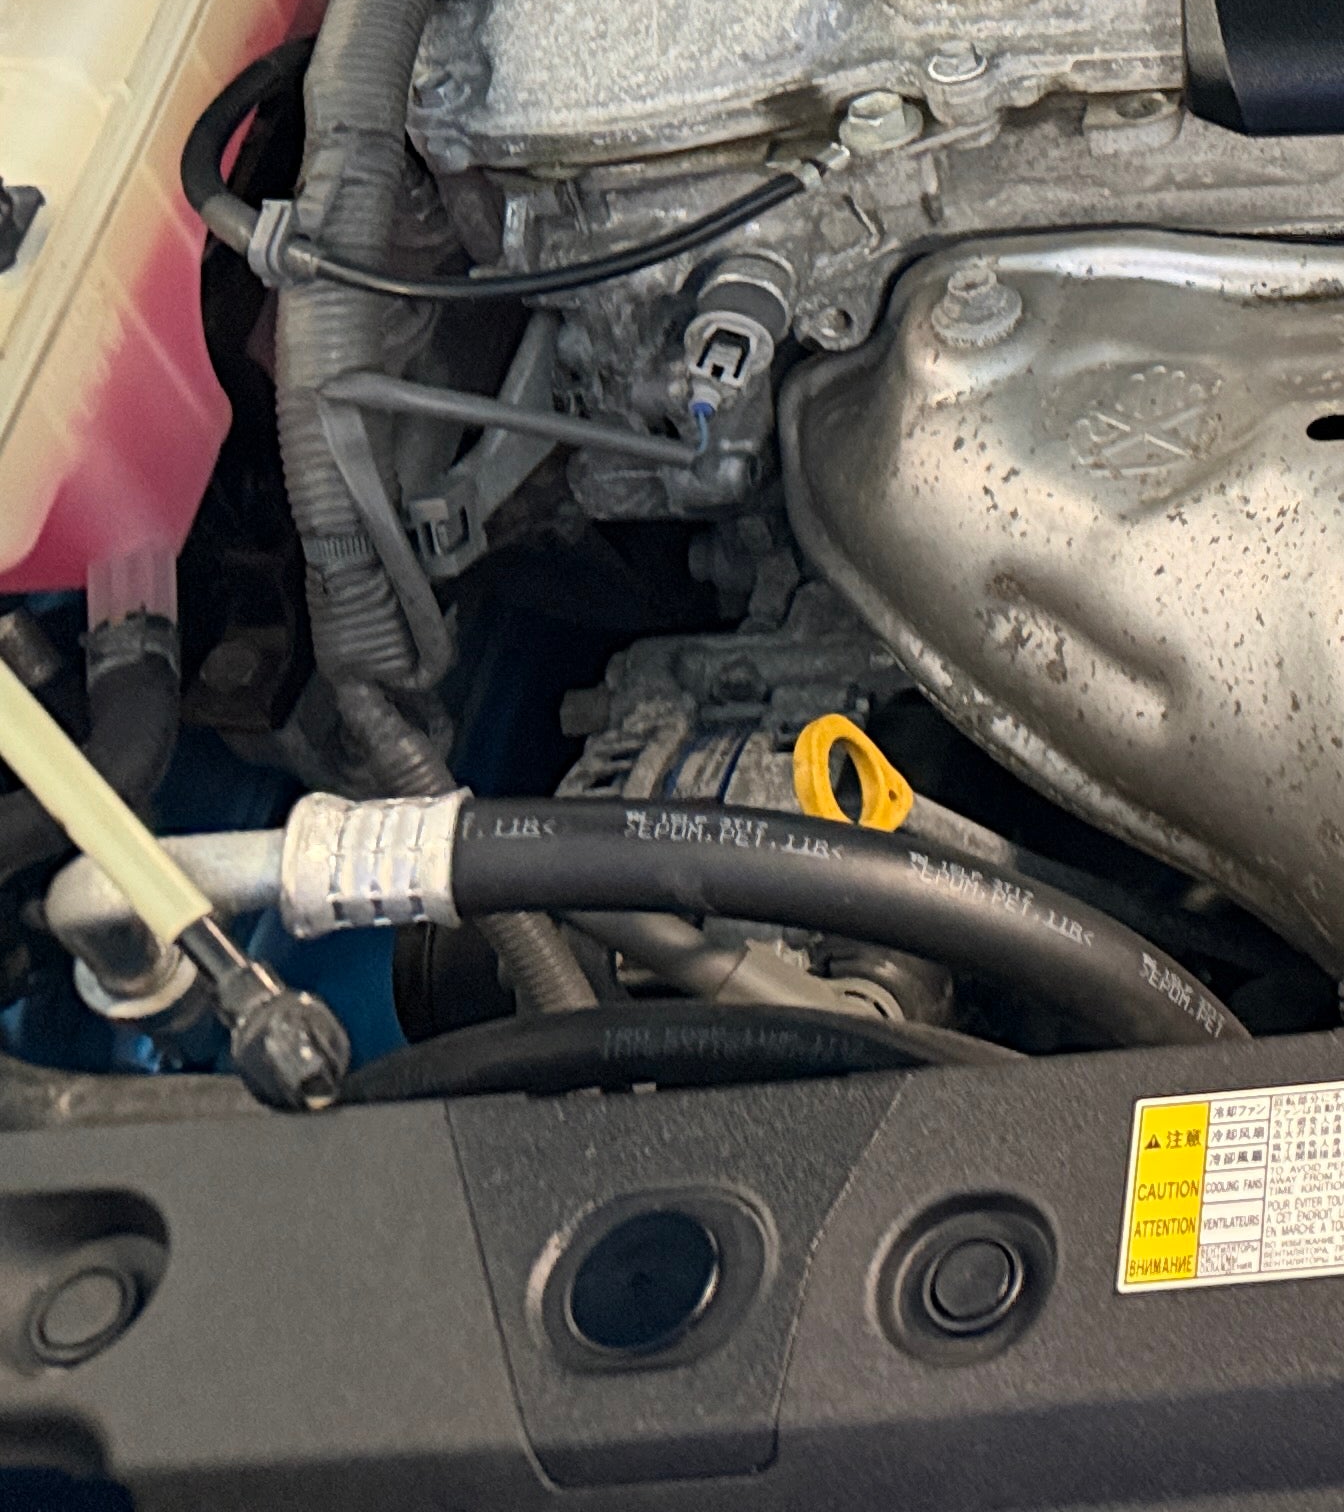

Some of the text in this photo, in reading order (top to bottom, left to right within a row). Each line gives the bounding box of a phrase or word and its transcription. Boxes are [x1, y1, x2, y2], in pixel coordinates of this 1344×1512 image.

[1137, 1179, 1200, 1202] CAUTION
[1205, 1177, 1263, 1194] COOLING FANS
[1133, 1216, 1197, 1238] ATTENTION
[1203, 1214, 1260, 1231] VENTILATEURS
[1129, 1254, 1194, 1278] ВНИМАНИЕ
